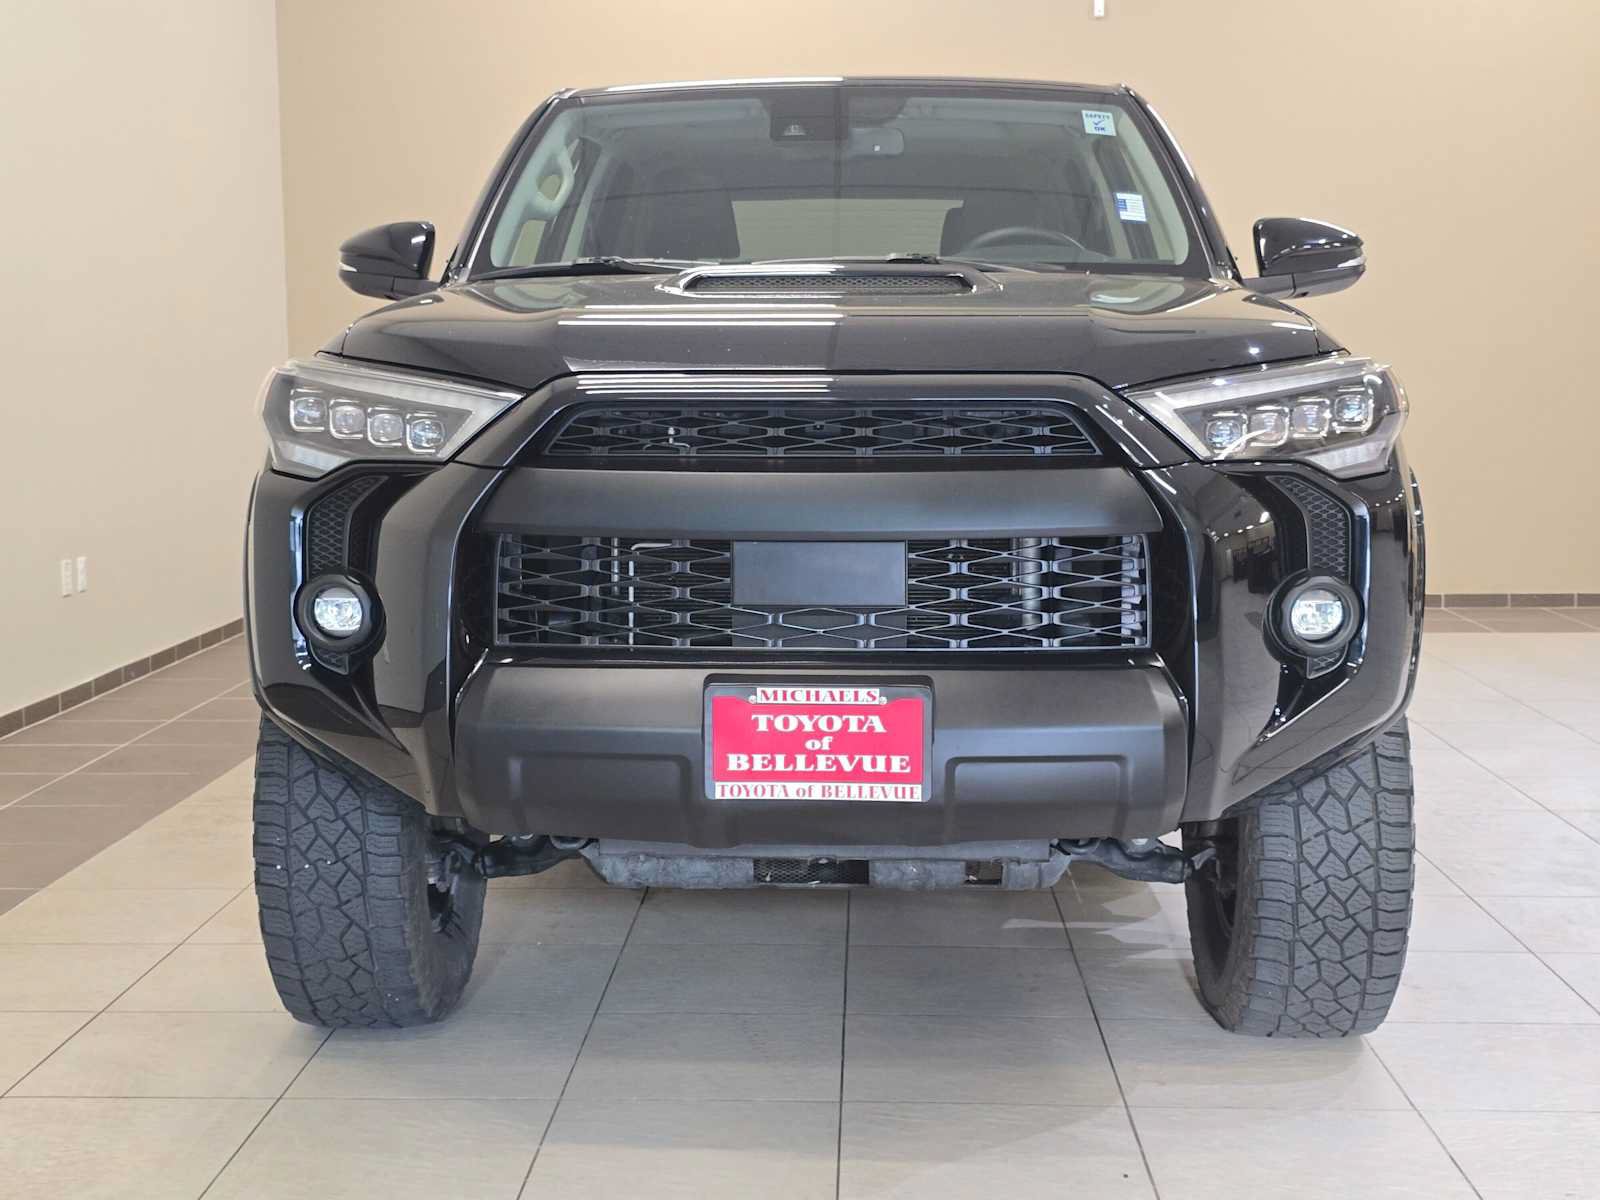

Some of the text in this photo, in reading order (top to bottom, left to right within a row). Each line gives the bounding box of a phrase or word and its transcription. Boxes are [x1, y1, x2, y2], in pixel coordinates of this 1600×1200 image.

[760, 689, 877, 703] MICHAELS
[751, 713, 887, 733] TOYOTA
[805, 736, 833, 750] of
[726, 753, 911, 773] BELLEVUE
[718, 783, 921, 800] TOYOTA of BELLEVUE
